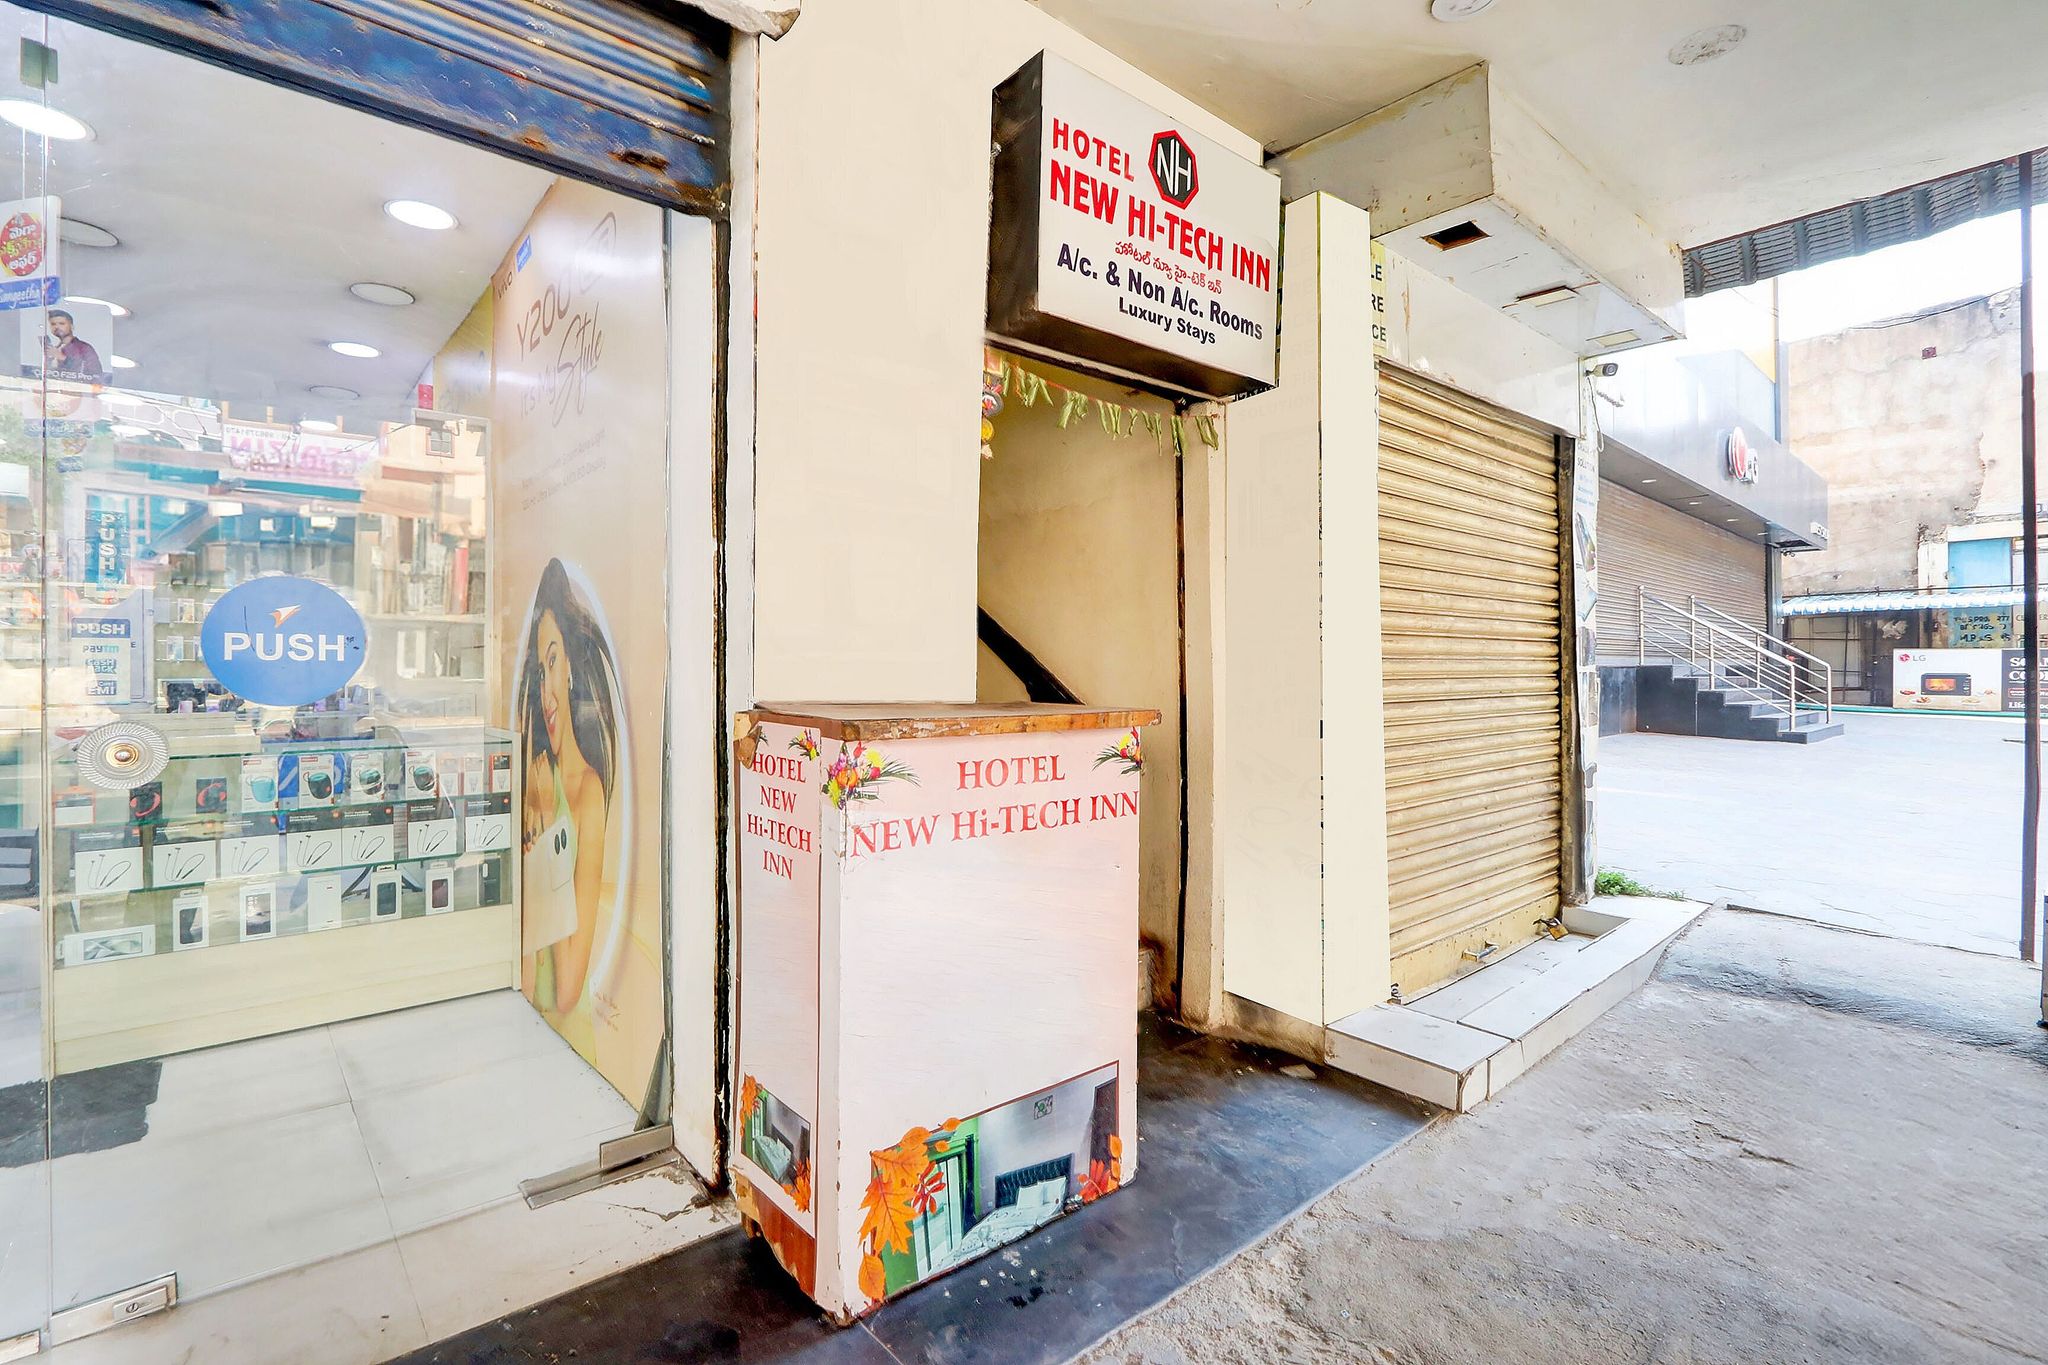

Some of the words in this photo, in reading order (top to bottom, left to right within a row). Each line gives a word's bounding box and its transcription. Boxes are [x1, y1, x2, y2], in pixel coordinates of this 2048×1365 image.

[1052, 117, 1135, 182] HOTEL
[1156, 139, 1192, 197] NH
[1050, 159, 1119, 225] NEW
[1128, 195, 1223, 272] HI-TECH
[1231, 242, 1271, 292] INN
[1057, 243, 1098, 280] A/c.
[1105, 260, 1121, 287] &
[1128, 268, 1165, 304] Non
[1171, 286, 1203, 318] A/c.
[1210, 299, 1263, 340] Rooms
[1118, 297, 1173, 332] Luxury
[1177, 317, 1216, 345] Stays
[61, 371, 77, 379] F25
[78, 372, 93, 380] Pro
[99, 513, 118, 570] PUSH
[76, 623, 125, 635] PUSH
[224, 632, 345, 662] PUSH
[1912, 654, 1927, 662] LG
[752, 752, 807, 784] HOTEL
[957, 754, 1066, 791] HOTEL
[760, 786, 797, 814] NEW
[747, 813, 812, 853] Hi-TECH
[850, 813, 940, 858] NEW
[951, 798, 1081, 842] Hi-TECH
[1089, 790, 1139, 822] INN
[763, 850, 793, 881] INN
